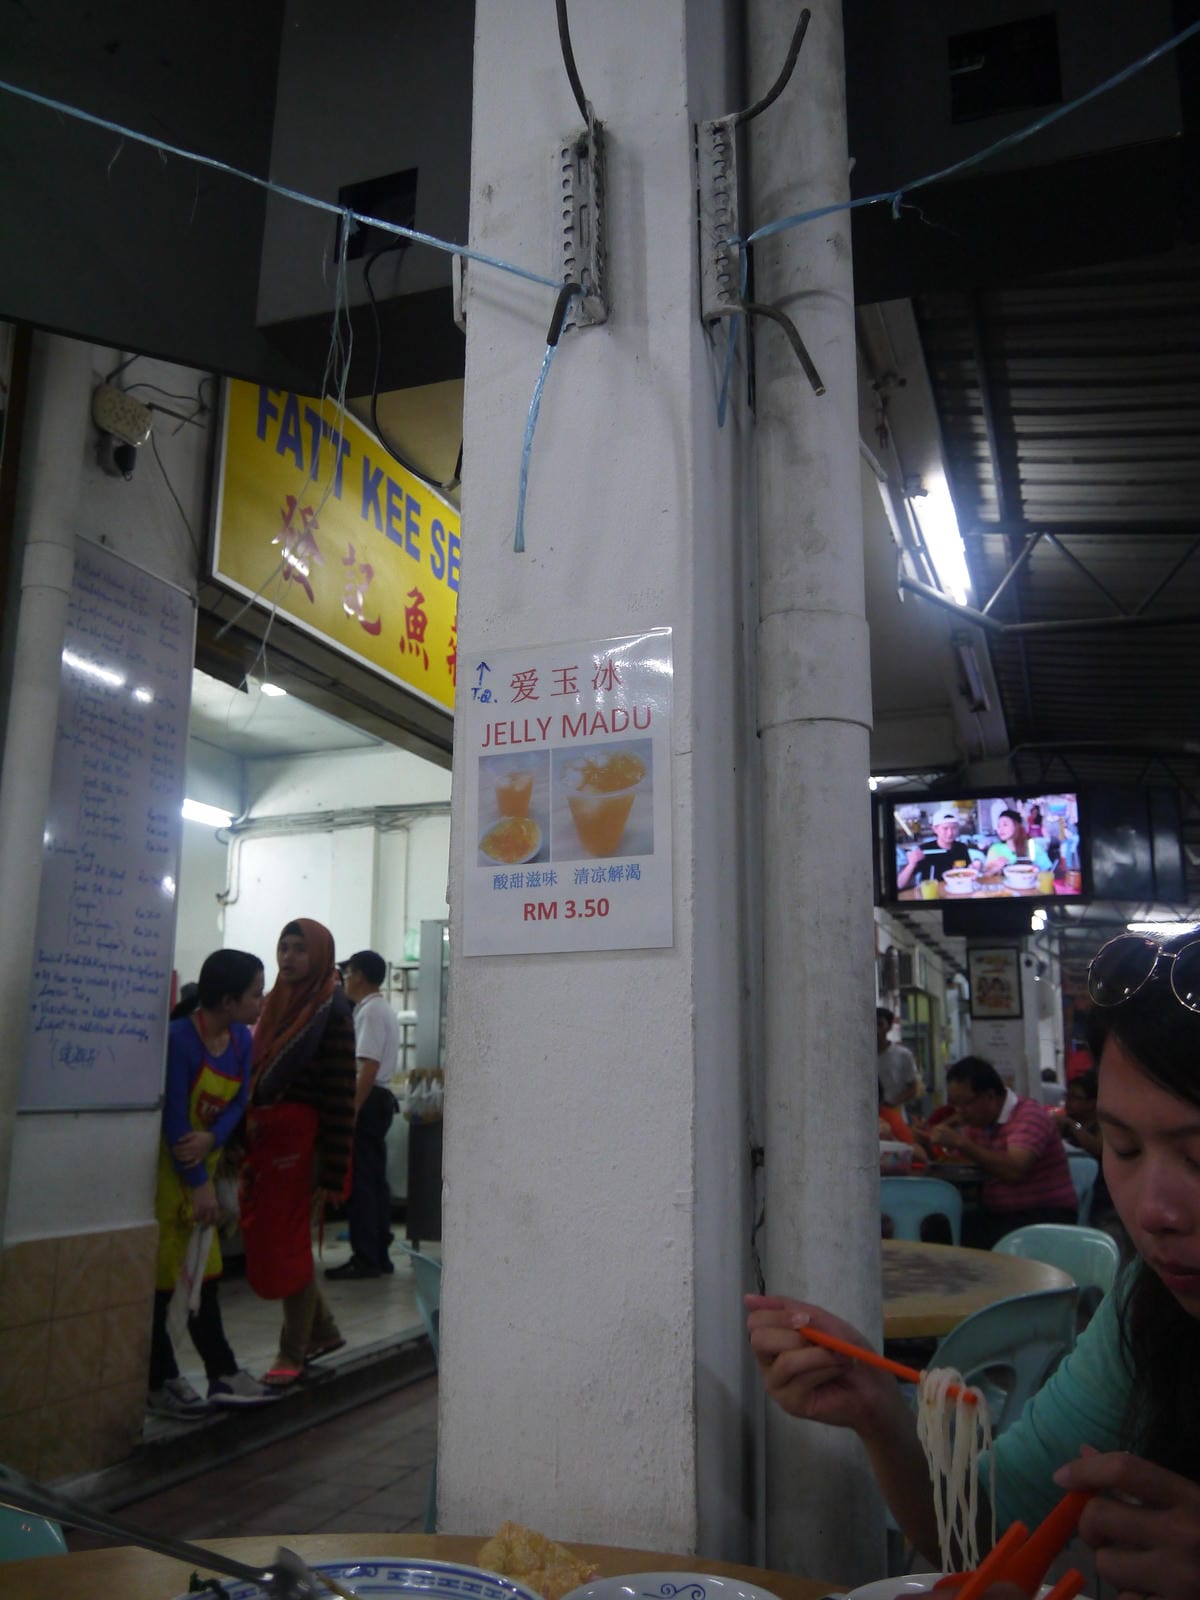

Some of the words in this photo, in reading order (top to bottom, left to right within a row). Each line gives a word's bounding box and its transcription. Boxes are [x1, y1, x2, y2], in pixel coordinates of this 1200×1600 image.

[256, 384, 351, 500] FATT
[361, 455, 421, 563] KEE
[509, 659, 623, 704] 爱玉冰
[481, 716, 553, 748] JELLY
[561, 704, 653, 739] MADU
[492, 869, 559, 891] 酸甜滋味
[573, 863, 641, 886] 清凉解渴
[523, 901, 558, 922] RM
[564, 897, 610, 919] 3.50
